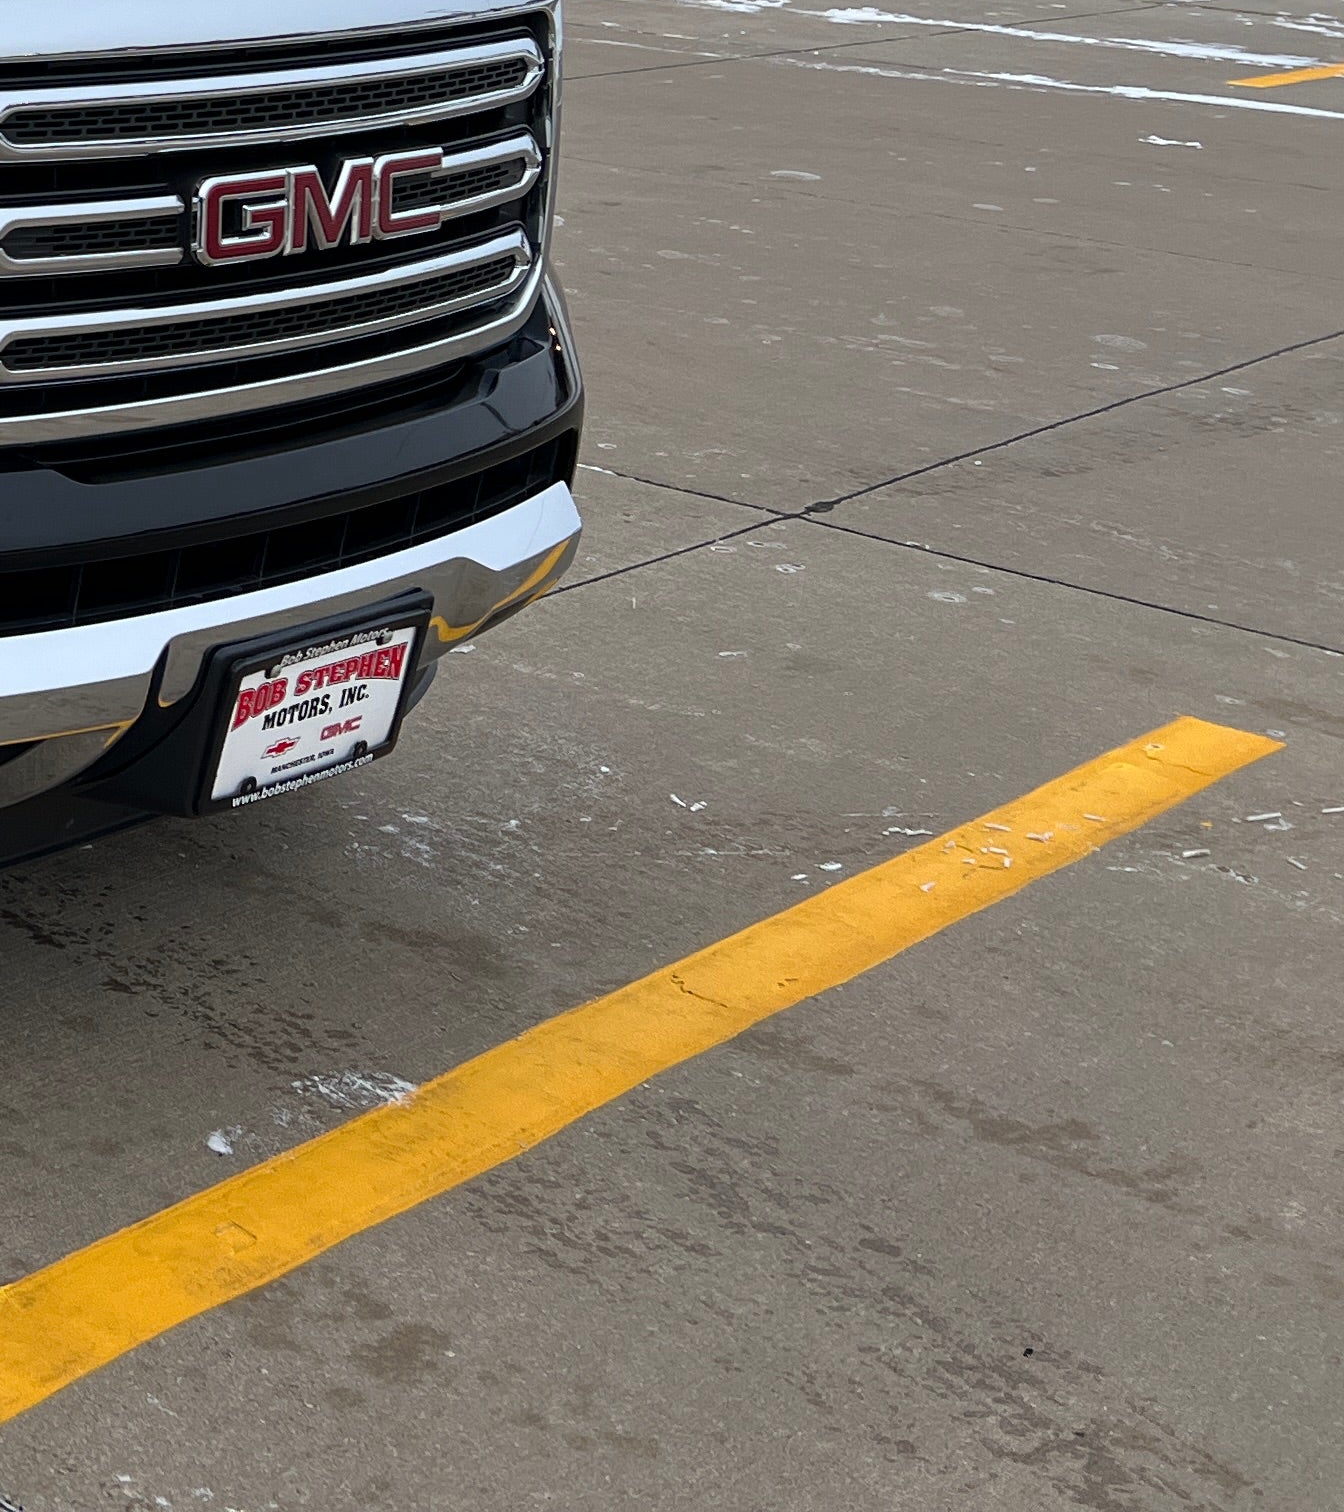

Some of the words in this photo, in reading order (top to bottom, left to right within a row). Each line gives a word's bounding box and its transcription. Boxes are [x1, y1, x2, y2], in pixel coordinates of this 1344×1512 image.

[197, 147, 444, 266] GMC
[279, 650, 304, 668] Bob
[303, 638, 349, 660] Stephen
[349, 627, 390, 647] Motors
[230, 677, 289, 733] BOB
[293, 642, 408, 696] STEPHEN
[261, 693, 333, 731] MOTORS,
[338, 684, 370, 709] INC.
[319, 714, 363, 742] GMC
[231, 753, 374, 808] www.bobstephenmotors.com
